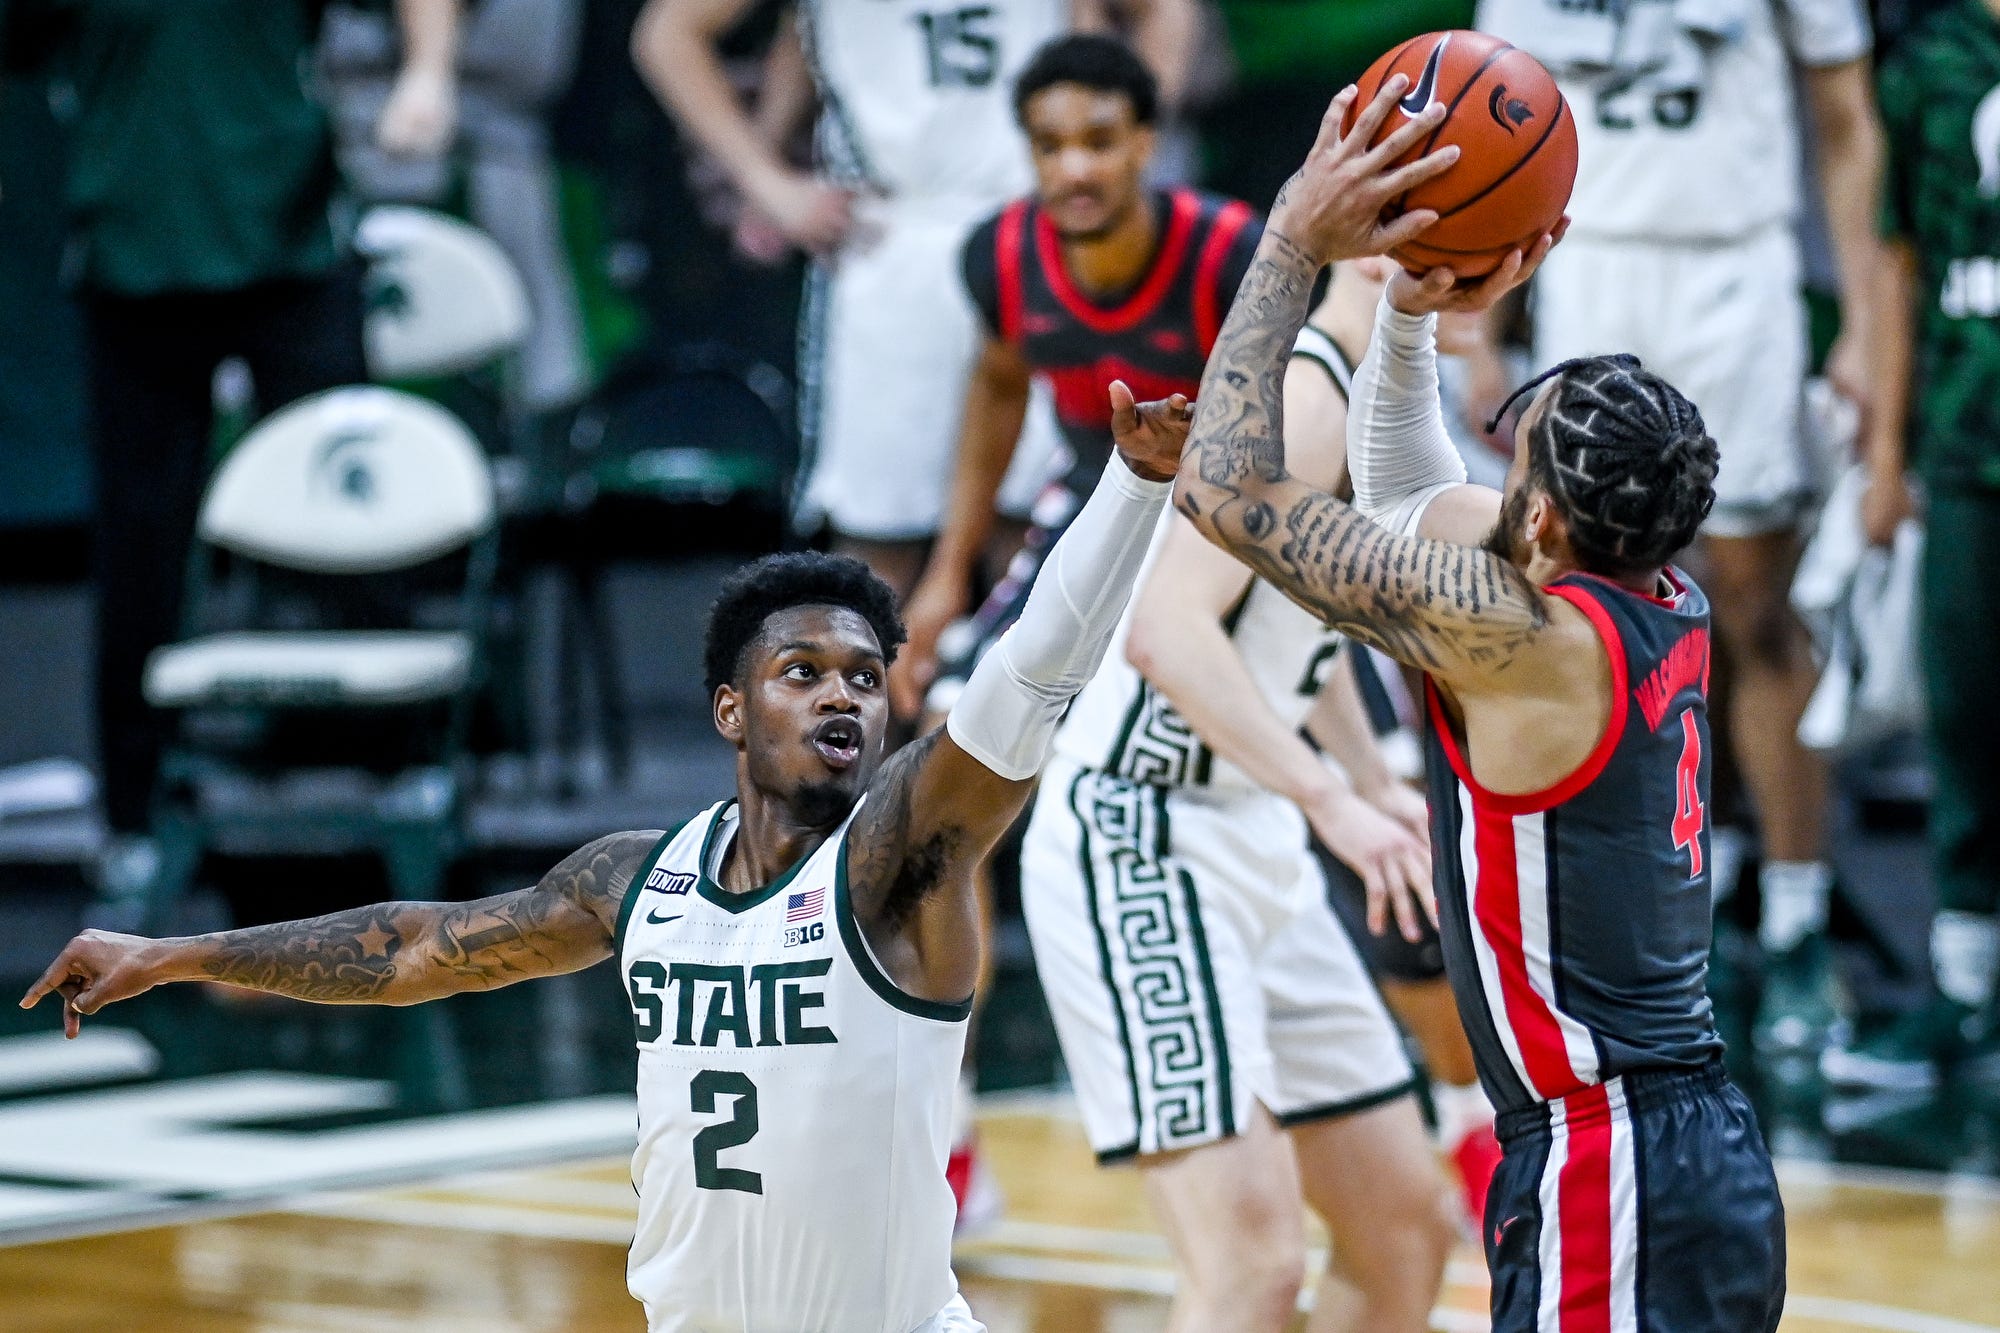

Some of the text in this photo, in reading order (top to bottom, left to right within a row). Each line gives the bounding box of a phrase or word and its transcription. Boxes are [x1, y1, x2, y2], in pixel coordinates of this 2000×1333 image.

[914, 5, 999, 87] 15
[1671, 707, 1704, 880] 4
[647, 868, 695, 894] UNITY
[629, 957, 839, 1048] STATE
[689, 1069, 763, 1195] 2
